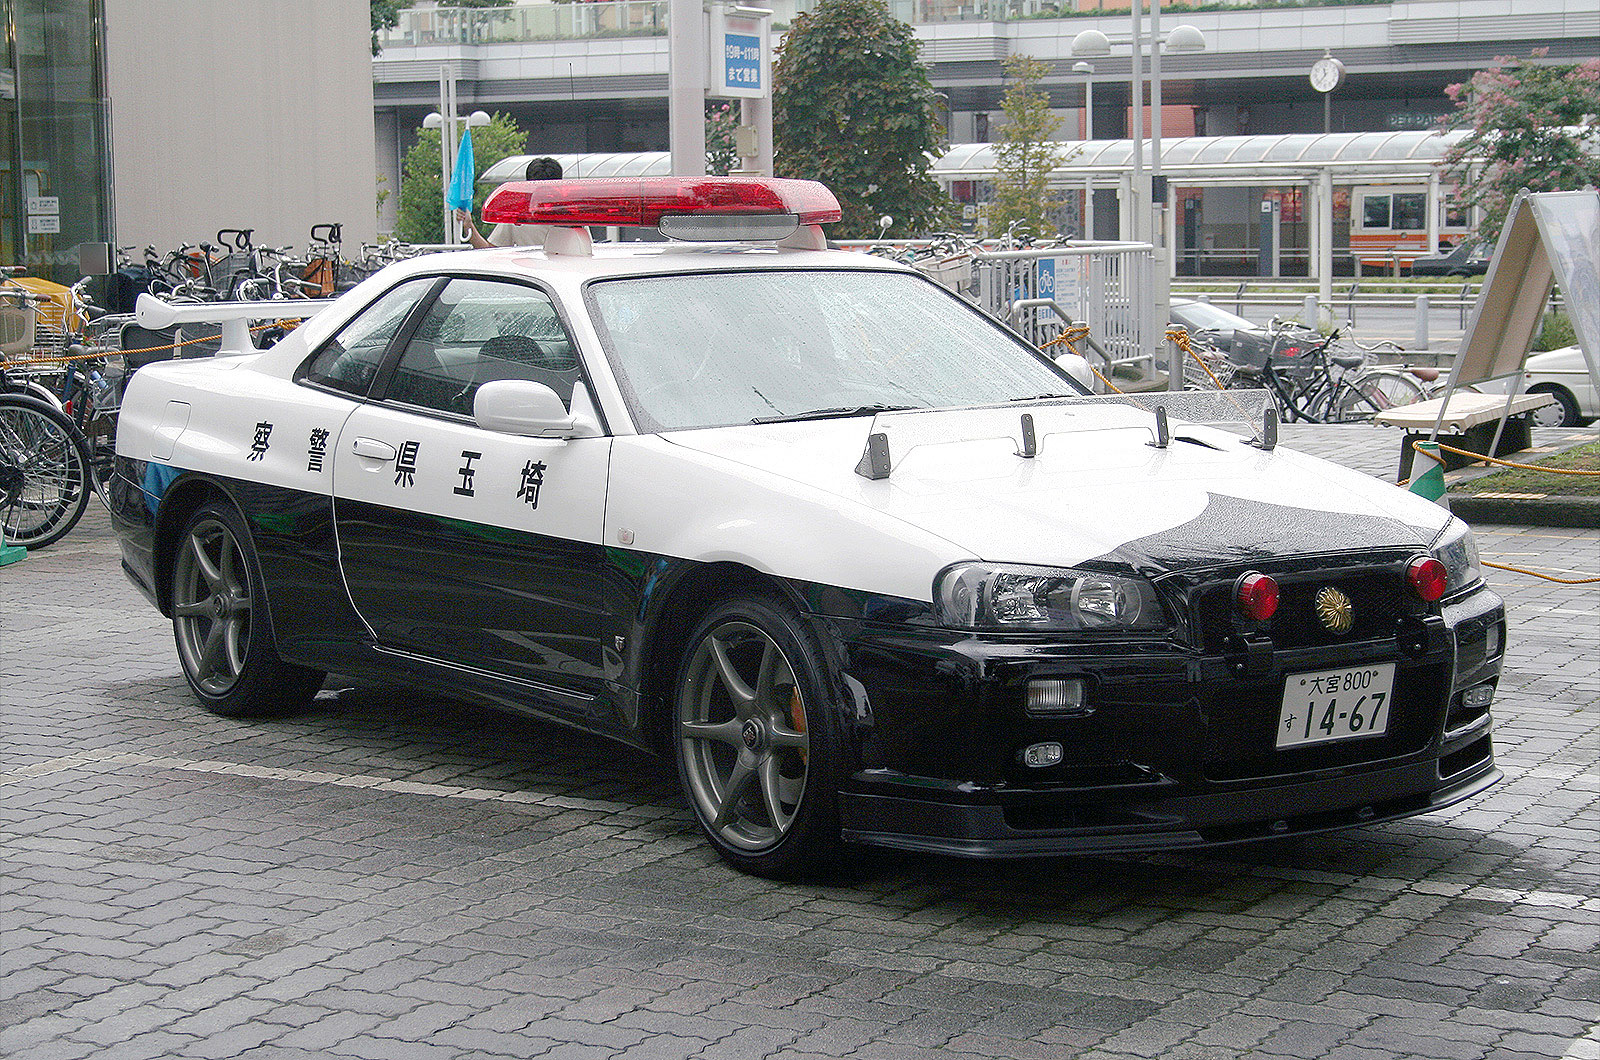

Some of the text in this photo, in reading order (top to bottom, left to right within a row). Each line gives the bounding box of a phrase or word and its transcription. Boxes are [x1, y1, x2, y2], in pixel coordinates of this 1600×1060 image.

[728, 66, 758, 82] まで営業
[1284, 692, 1386, 738] す 14-67
